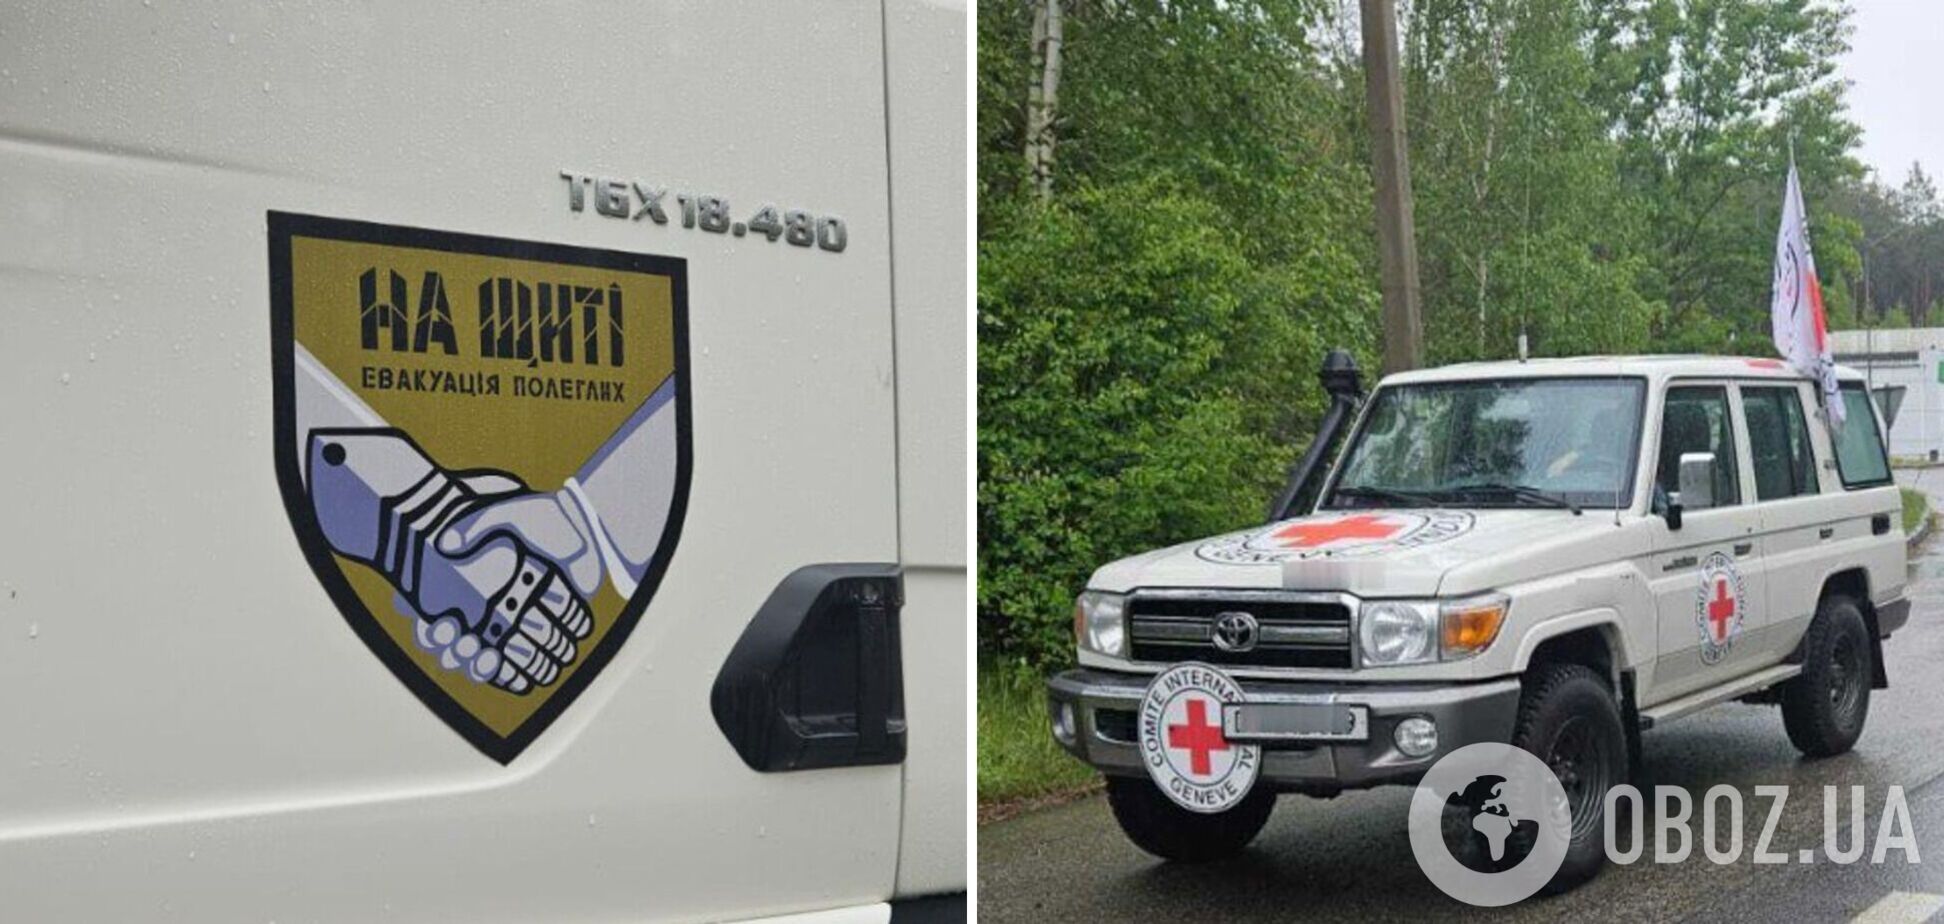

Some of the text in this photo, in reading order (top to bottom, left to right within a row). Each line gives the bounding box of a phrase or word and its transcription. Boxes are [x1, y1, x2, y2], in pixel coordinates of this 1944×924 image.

[677, 191, 848, 254] 18.480
[359, 266, 625, 368] НА ЩИТІ
[361, 366, 501, 397] ЕВАКУАЦІЯ
[1169, 776, 1237, 806] GENEVE
